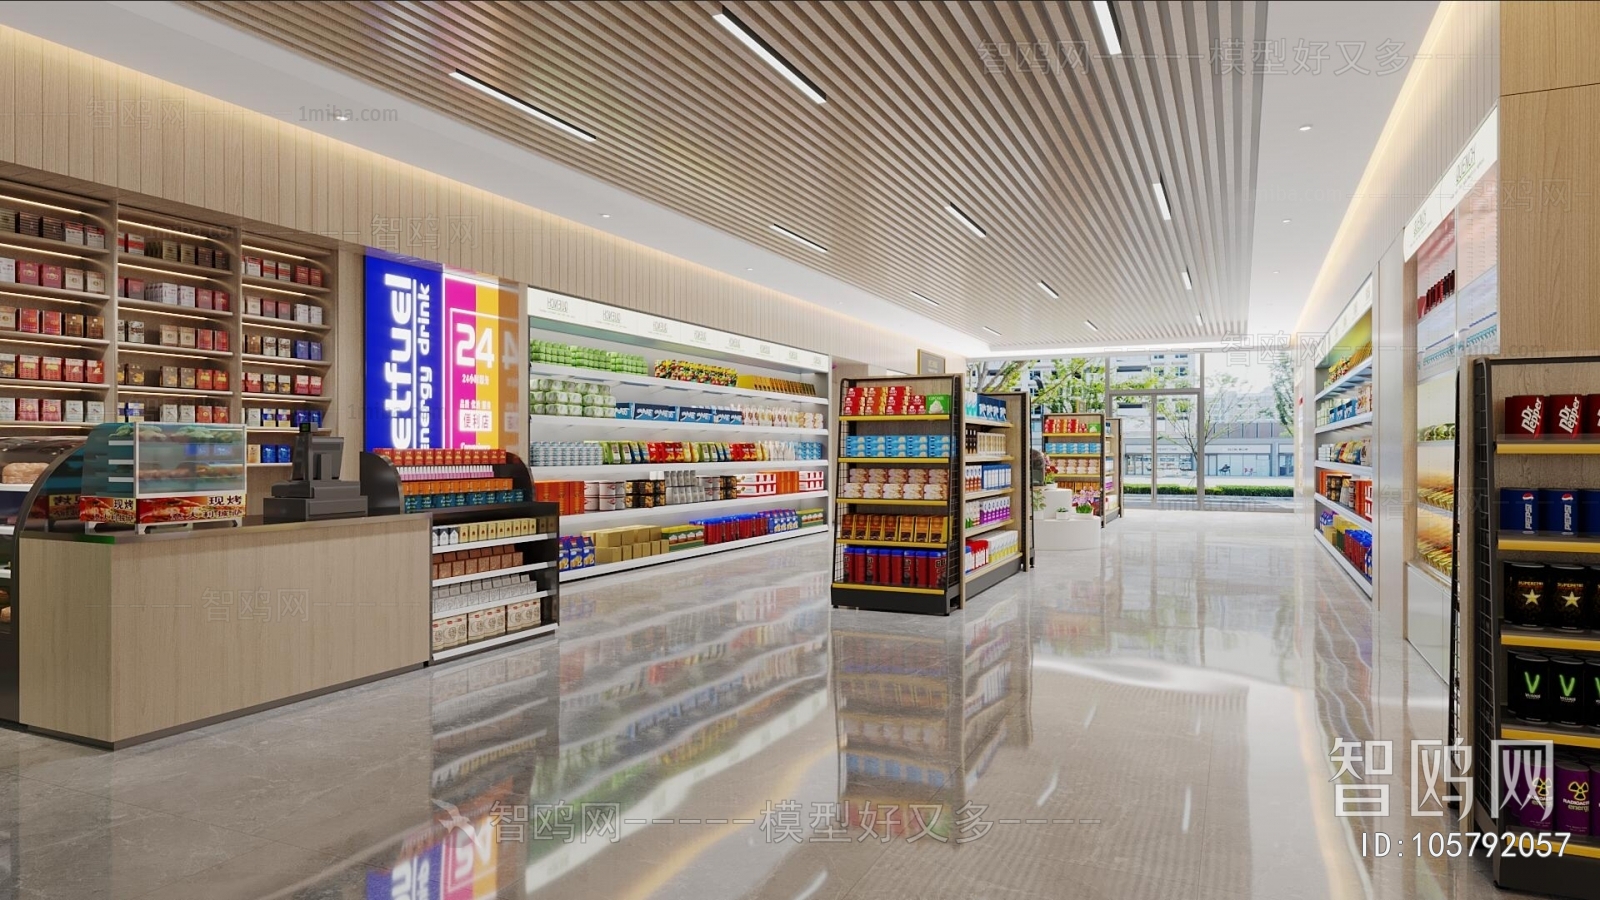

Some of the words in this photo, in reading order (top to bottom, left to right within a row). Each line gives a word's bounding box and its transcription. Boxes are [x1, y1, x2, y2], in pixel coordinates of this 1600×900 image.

[417, 282, 430, 355] drink
[455, 323, 495, 369] 24
[463, 413, 490, 429] 便利店
[1521, 397, 1542, 434] Pepper
[1558, 396, 1580, 434] Pepper
[114, 499, 134, 510] 现烤
[208, 495, 242, 506] 现烤
[1524, 503, 1533, 530] PEPSI
[1564, 504, 1572, 531] PEPSI
[1524, 671, 1540, 694] V
[1559, 674, 1575, 697] V
